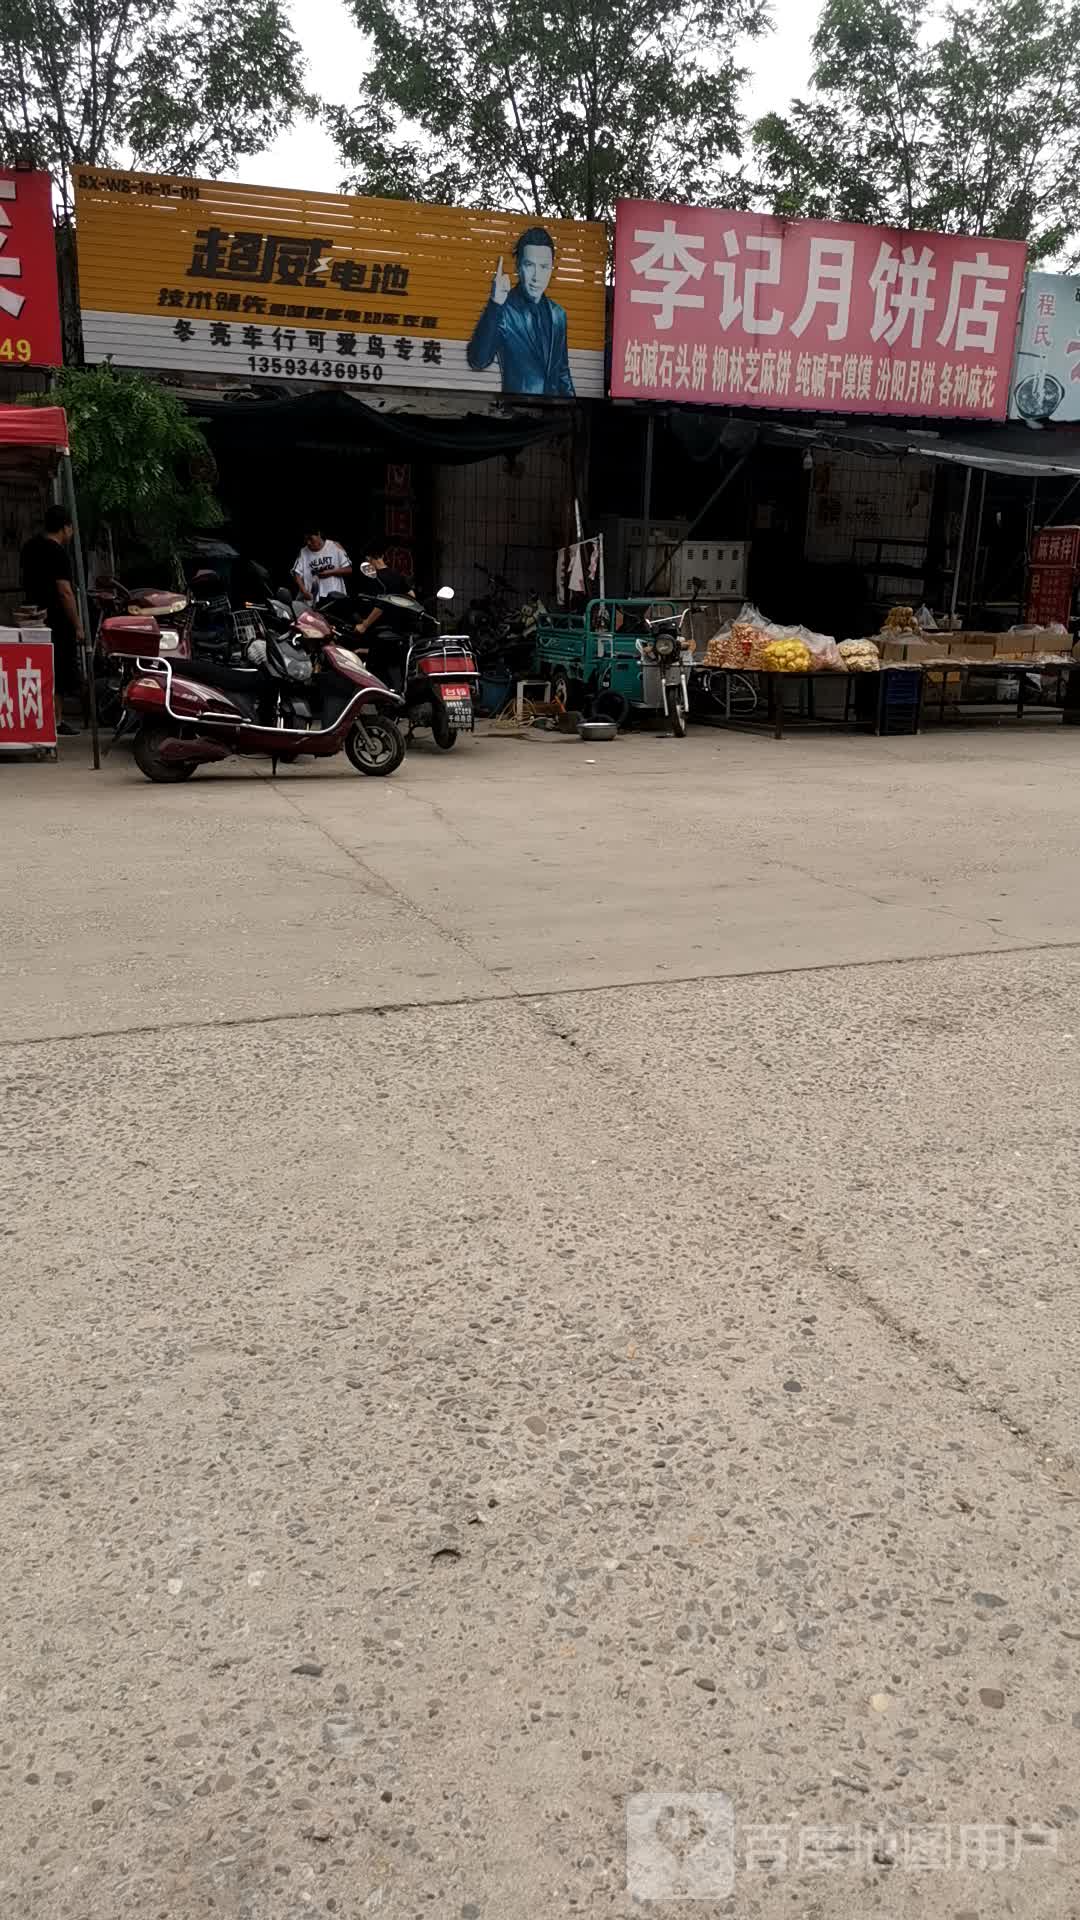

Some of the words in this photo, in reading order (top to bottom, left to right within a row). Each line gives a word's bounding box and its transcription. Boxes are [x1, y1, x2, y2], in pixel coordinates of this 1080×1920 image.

[630, 219, 1009, 353] 李记月饼店
[173, 319, 443, 365] 冬亮车行可爱鸟专卖
[248, 356, 383, 381] 13593436950
[623, 339, 707, 391] 纯碱石头饼
[711, 345, 792, 396] 柳林芝麻饼
[875, 357, 936, 405] 汾阳月饼
[939, 362, 998, 409] 各种麻花
